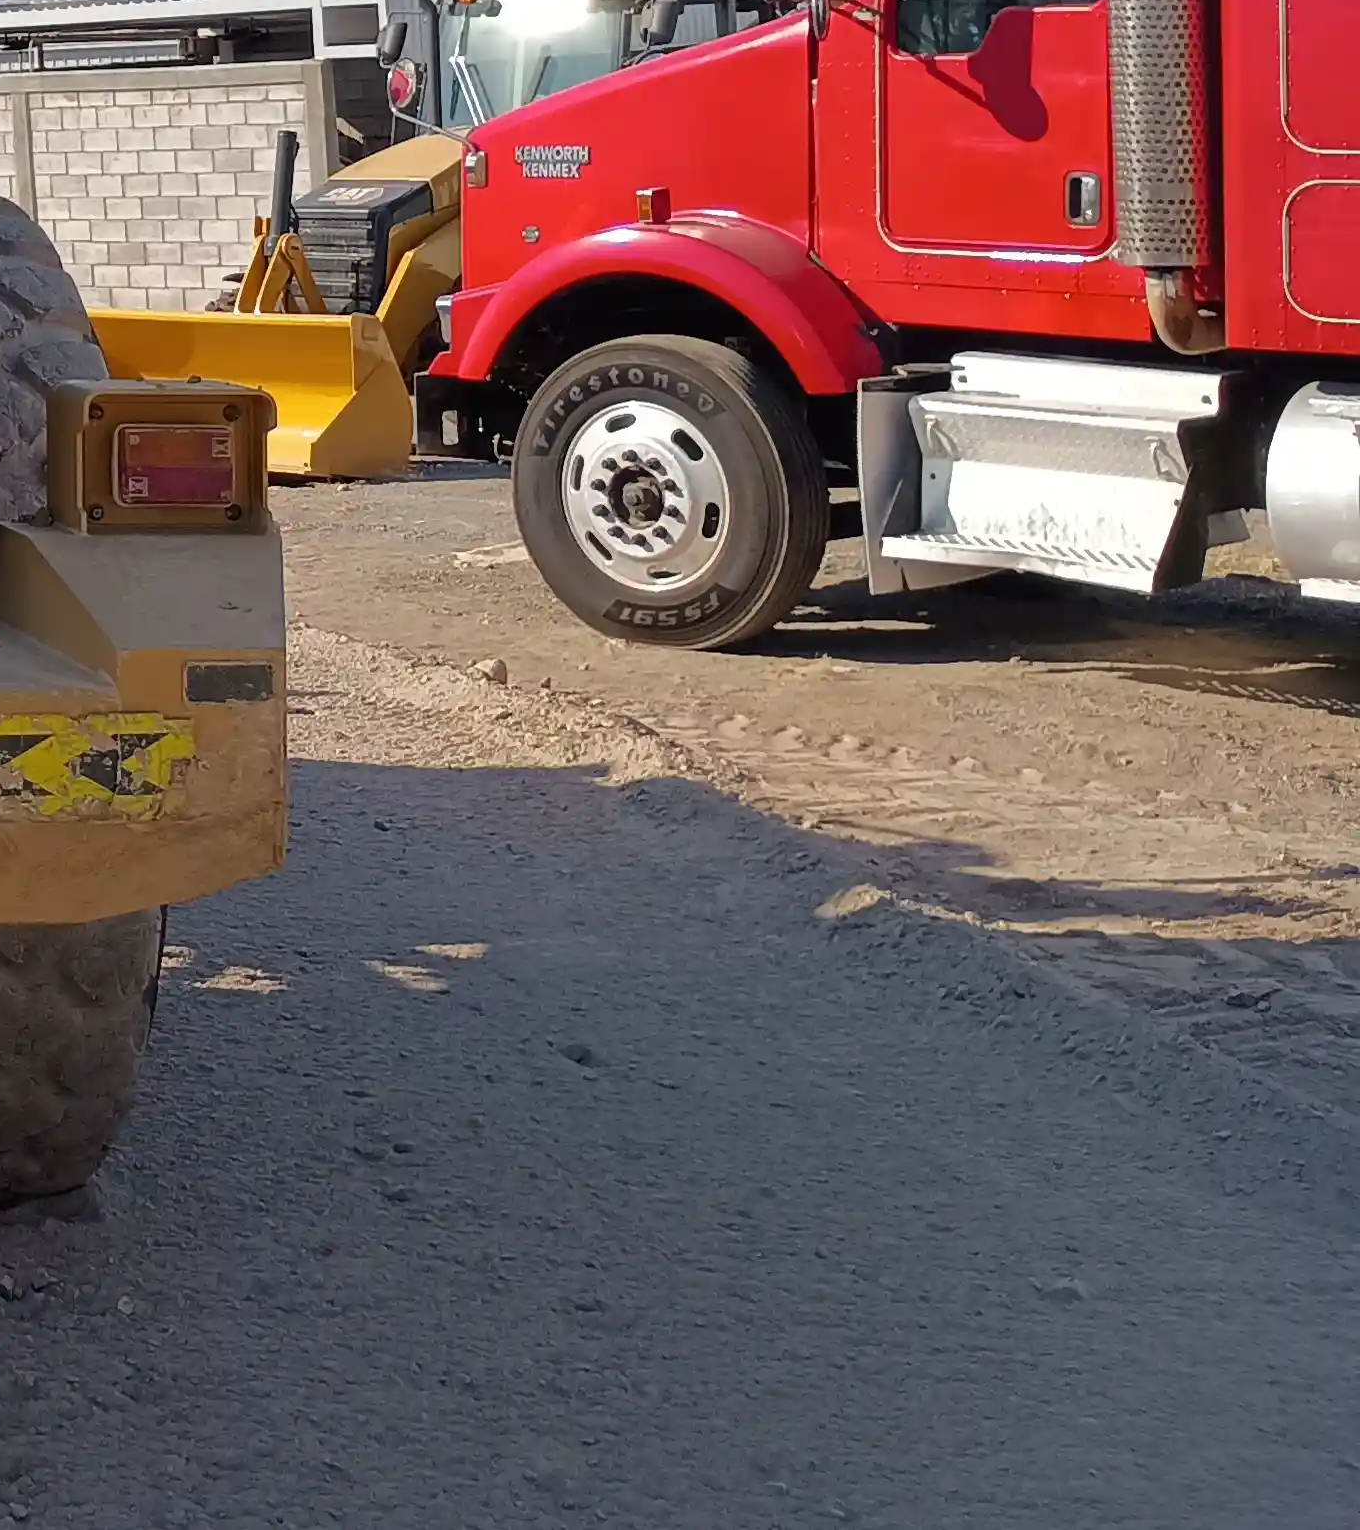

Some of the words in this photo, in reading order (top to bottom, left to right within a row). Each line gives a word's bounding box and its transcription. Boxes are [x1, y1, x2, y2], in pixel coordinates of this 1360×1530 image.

[514, 145, 592, 164] KENWORTH
[522, 162, 582, 179] KENMEX
[533, 366, 691, 449] Firestone
